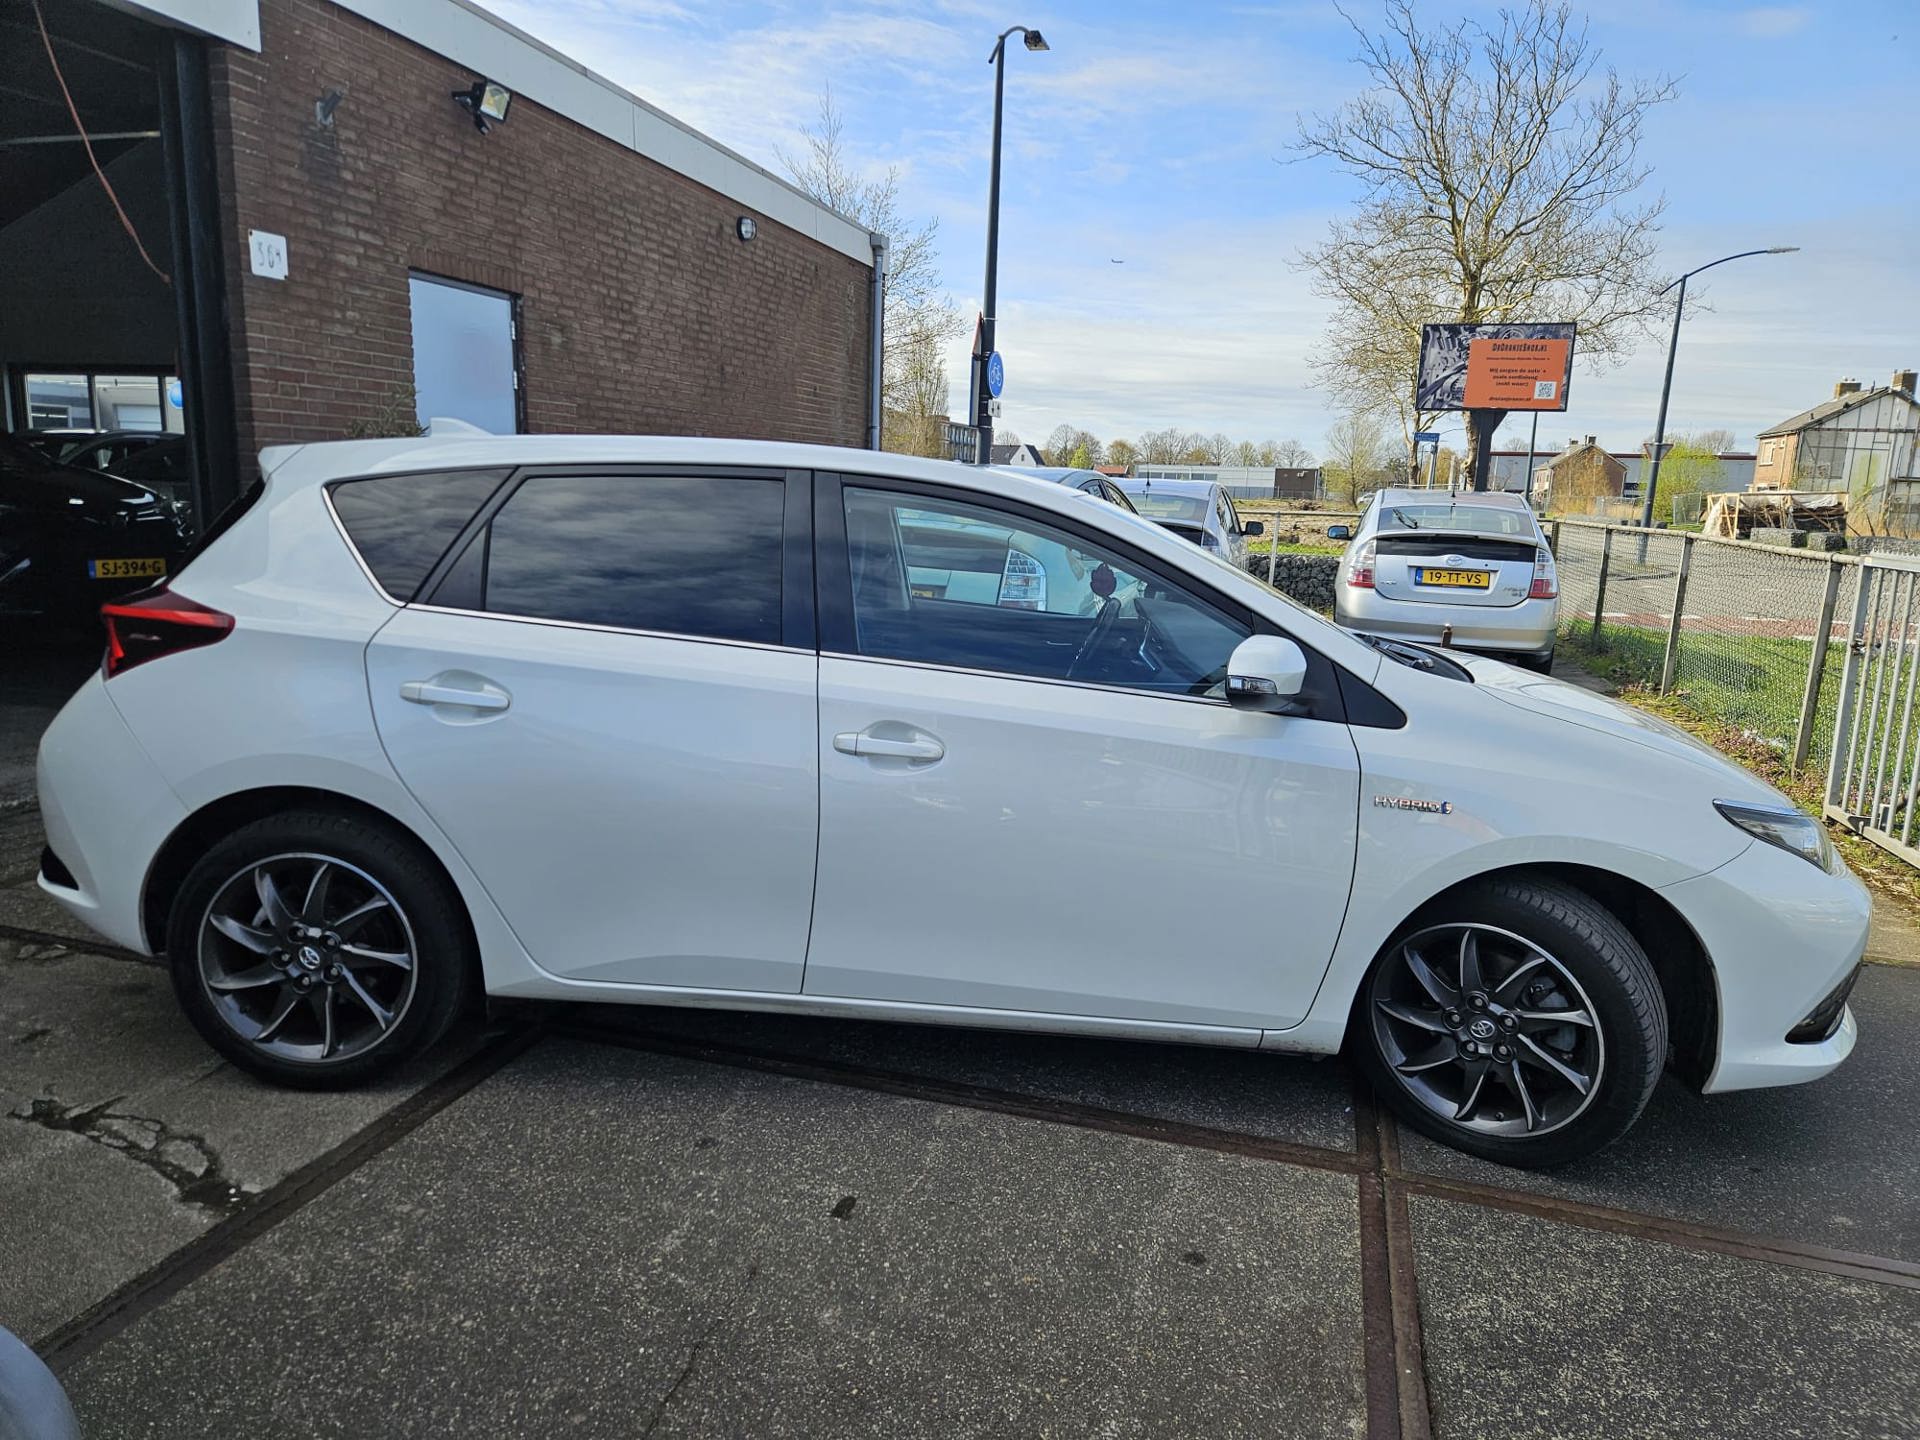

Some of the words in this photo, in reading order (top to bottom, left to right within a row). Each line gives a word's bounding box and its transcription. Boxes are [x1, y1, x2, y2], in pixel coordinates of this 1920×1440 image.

[101, 560, 162, 576] SJ-394-G
[1428, 570, 1482, 585] 19-TT-VS
[1374, 795, 1440, 813] HYBRID
